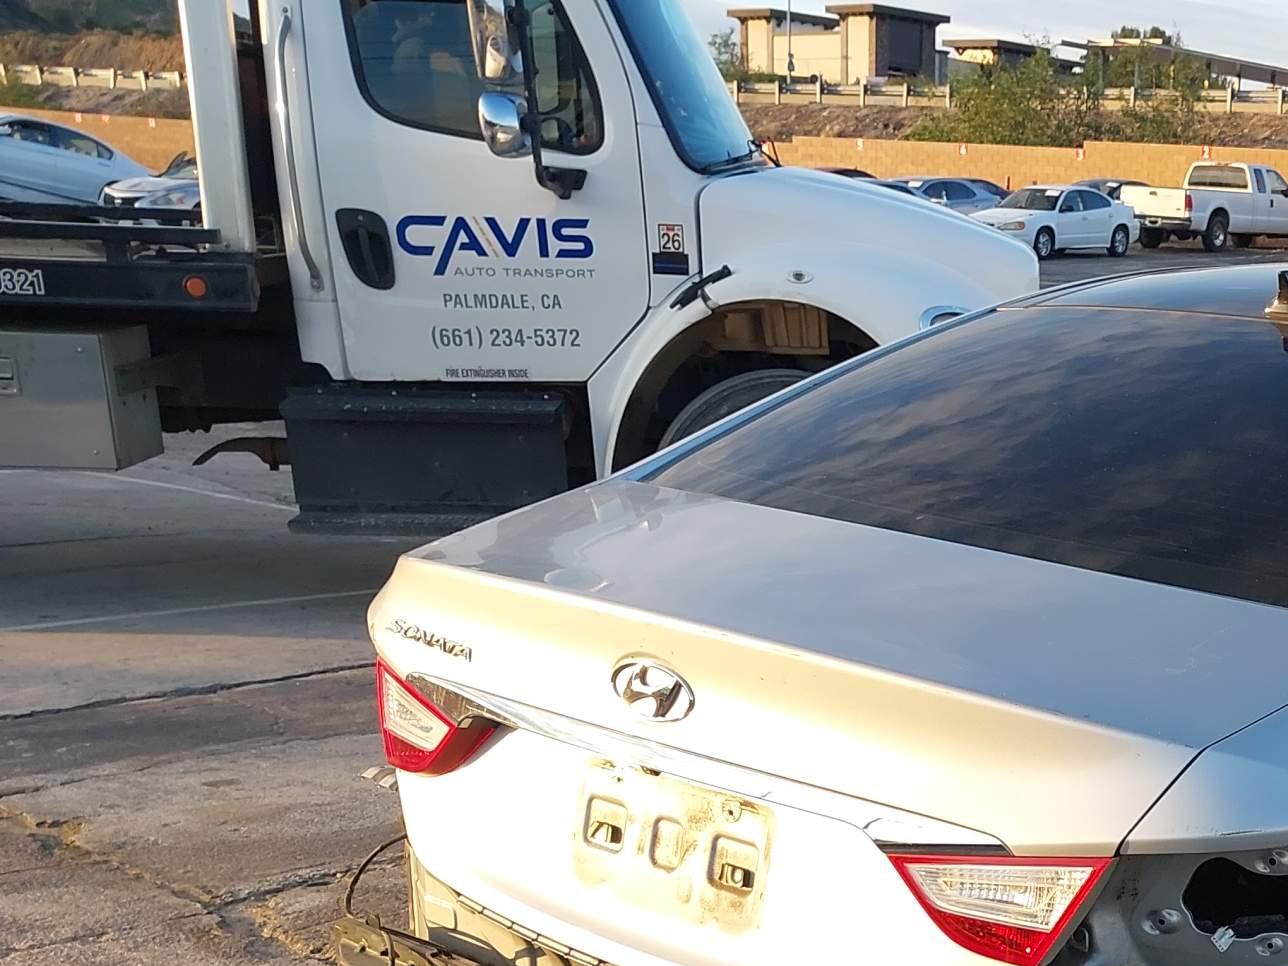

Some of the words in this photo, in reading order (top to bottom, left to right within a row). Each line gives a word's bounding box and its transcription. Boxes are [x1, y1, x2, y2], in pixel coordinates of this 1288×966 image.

[396, 215, 594, 276] CAVIS
[661, 232, 682, 251] 26
[0, 268, 45, 295] 321
[454, 267, 496, 277] AUTO
[502, 267, 596, 279] TRANSPORT
[443, 293, 535, 311] PALMDALE,
[541, 293, 562, 310] CA
[431, 326, 483, 349] (661)
[489, 327, 581, 348] 234-5372
[384, 617, 473, 663] SONATA
